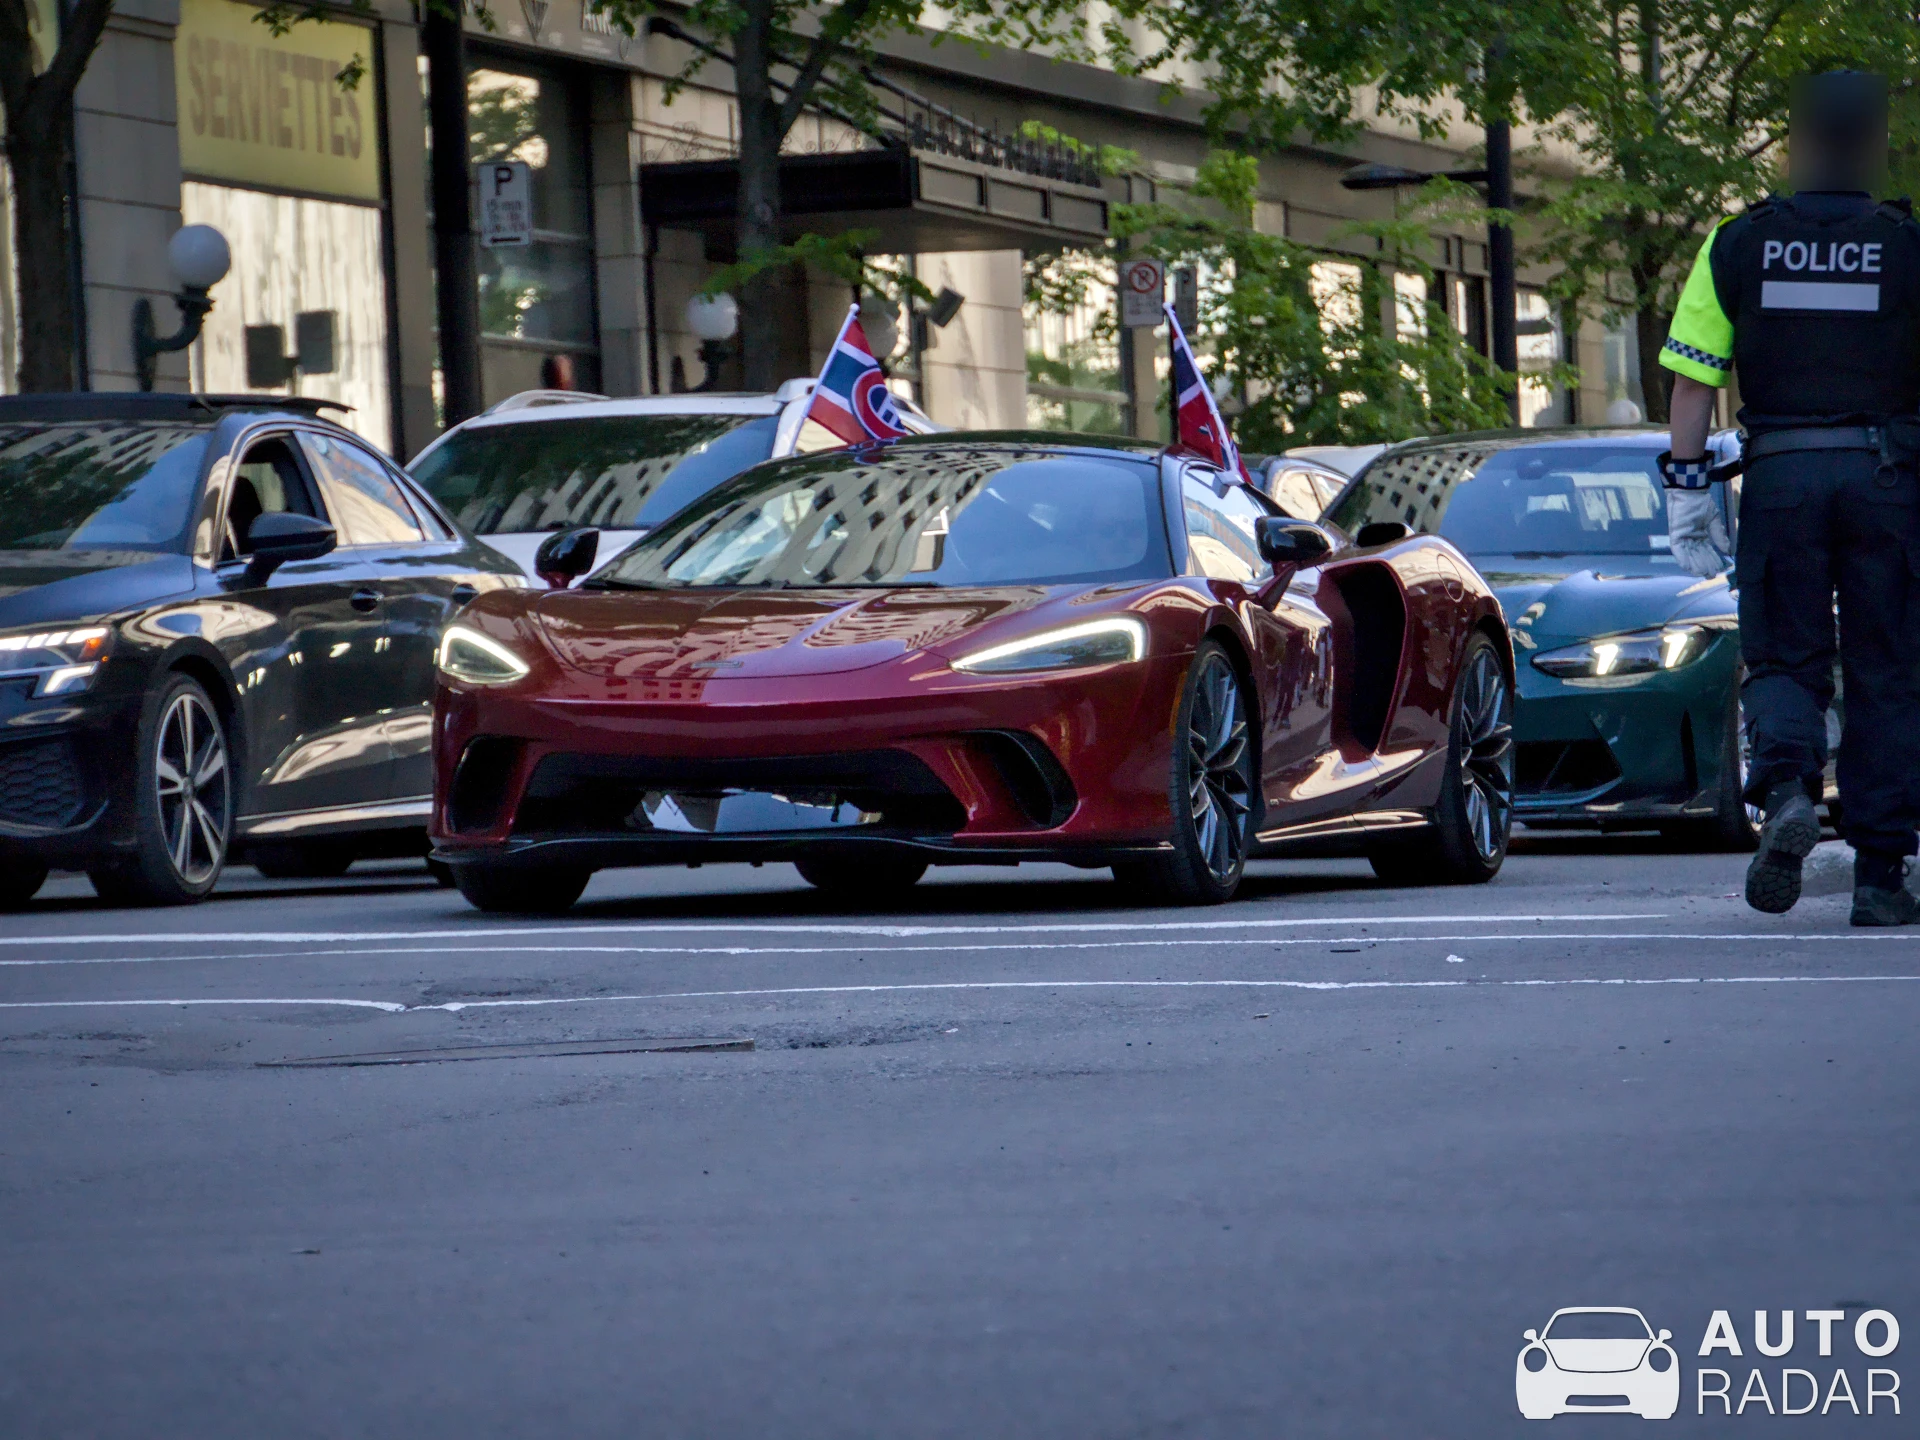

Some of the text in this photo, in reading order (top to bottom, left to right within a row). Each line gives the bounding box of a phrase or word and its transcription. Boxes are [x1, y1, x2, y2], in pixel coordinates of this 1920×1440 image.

[187, 33, 363, 160] SERVIETTES
[494, 166, 512, 195] P
[1763, 240, 1882, 272] POLICE
